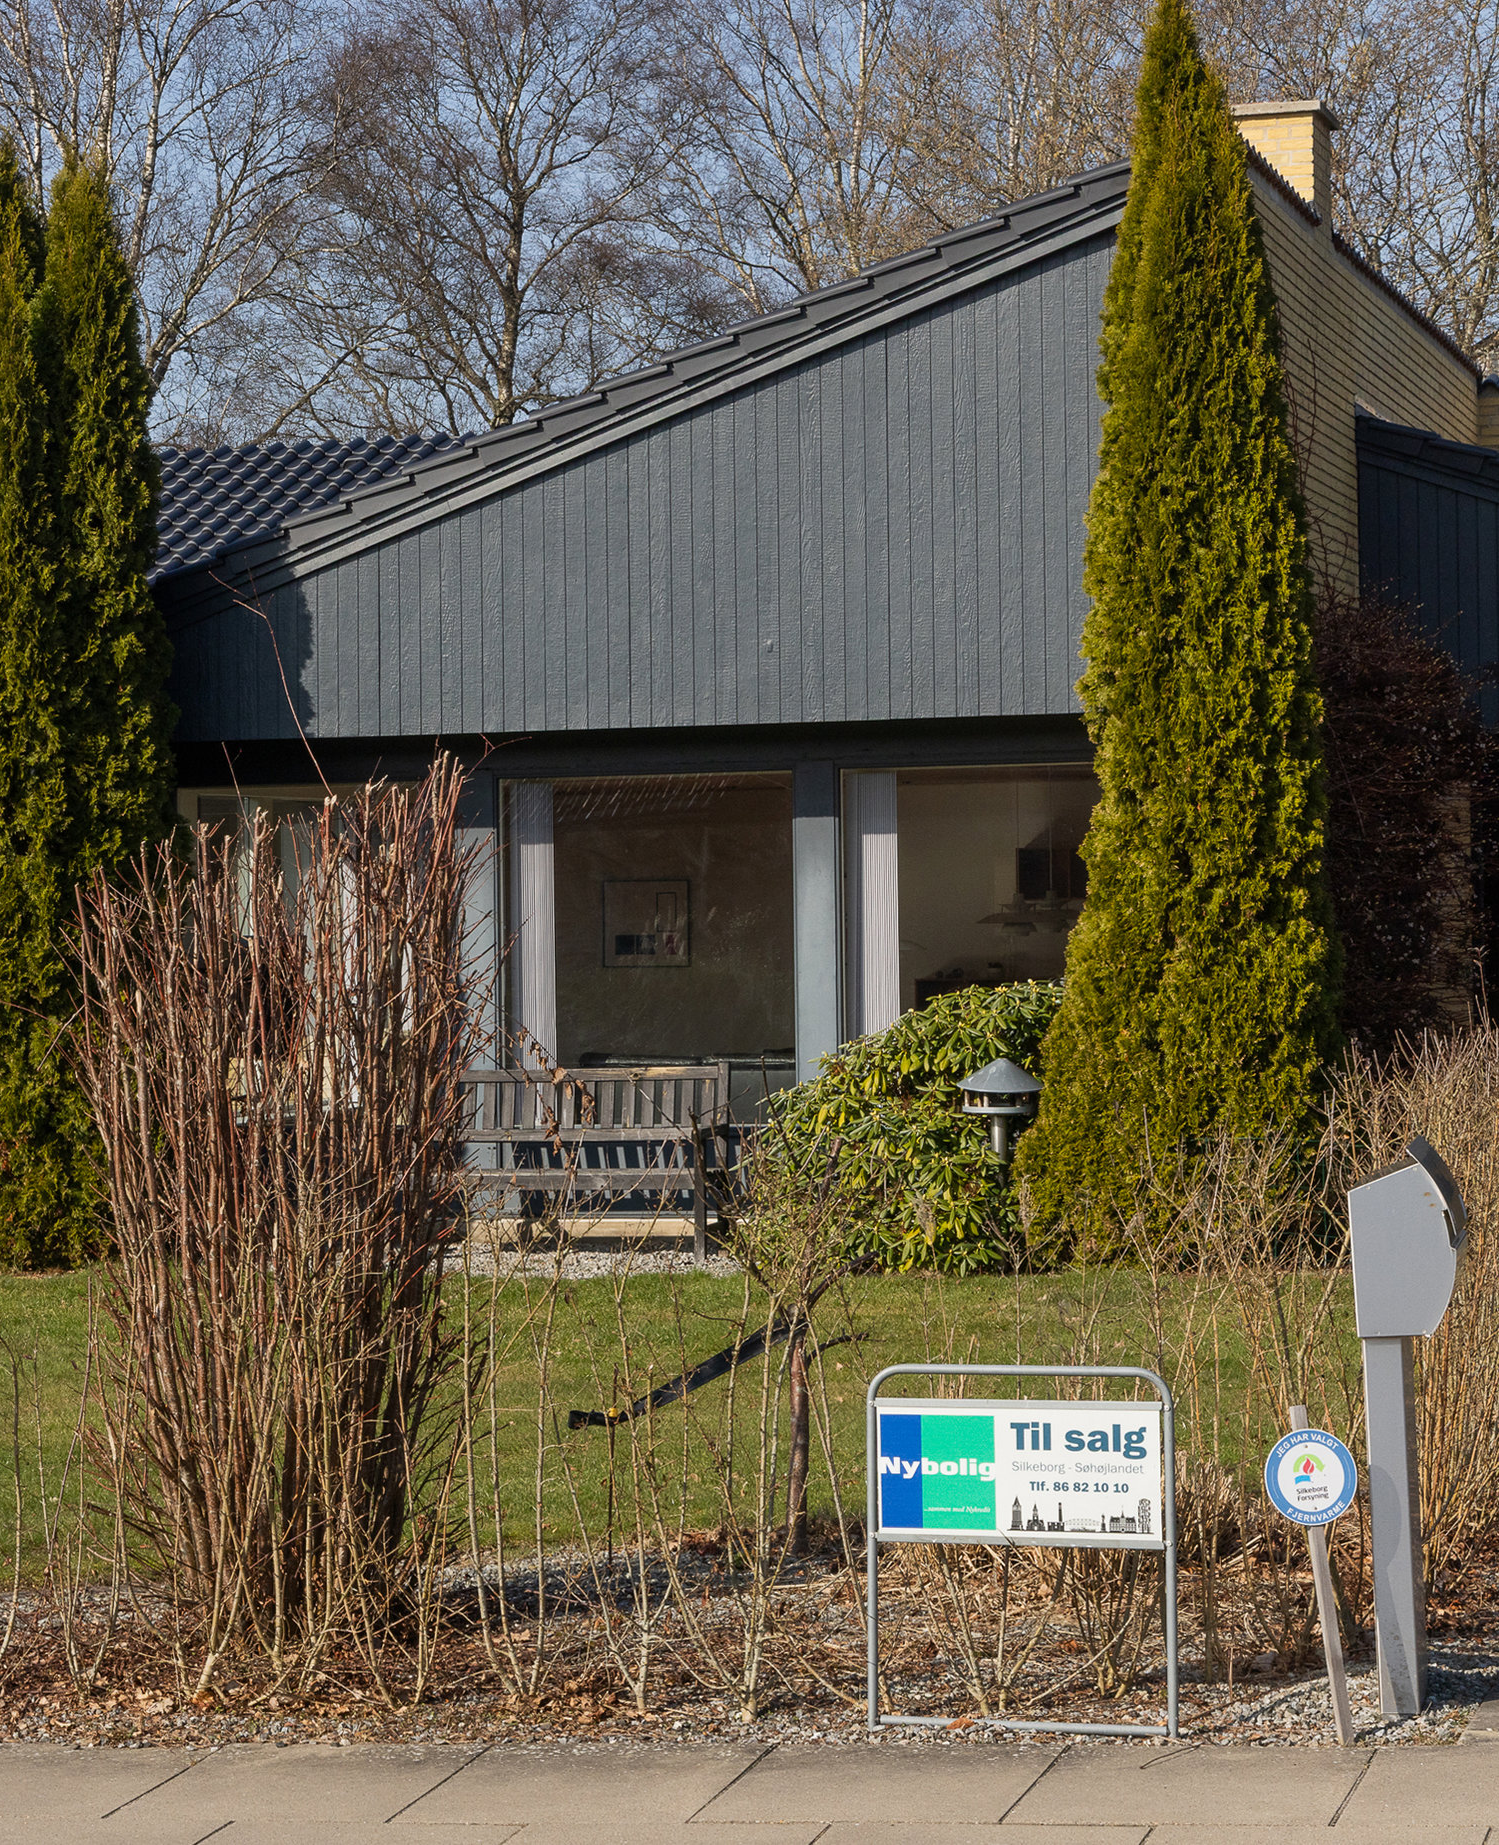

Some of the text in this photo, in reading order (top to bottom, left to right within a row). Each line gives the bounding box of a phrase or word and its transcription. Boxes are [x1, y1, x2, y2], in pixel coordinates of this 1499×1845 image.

[1010, 1421, 1147, 1460] Til salg
[1276, 1433, 1338, 1458] JEG HAR VALGT
[880, 1456, 996, 1482] Nybolig
[1011, 1461, 1066, 1474] Silkeborg
[1074, 1462, 1144, 1475] Søhøjlandet
[1029, 1481, 1129, 1494] Tlf. 86 82 10 10
[1296, 1486, 1328, 1494] Silkeborg
[1297, 1492, 1329, 1502] Forsyning
[1287, 1501, 1345, 1522] FJERNVARME
